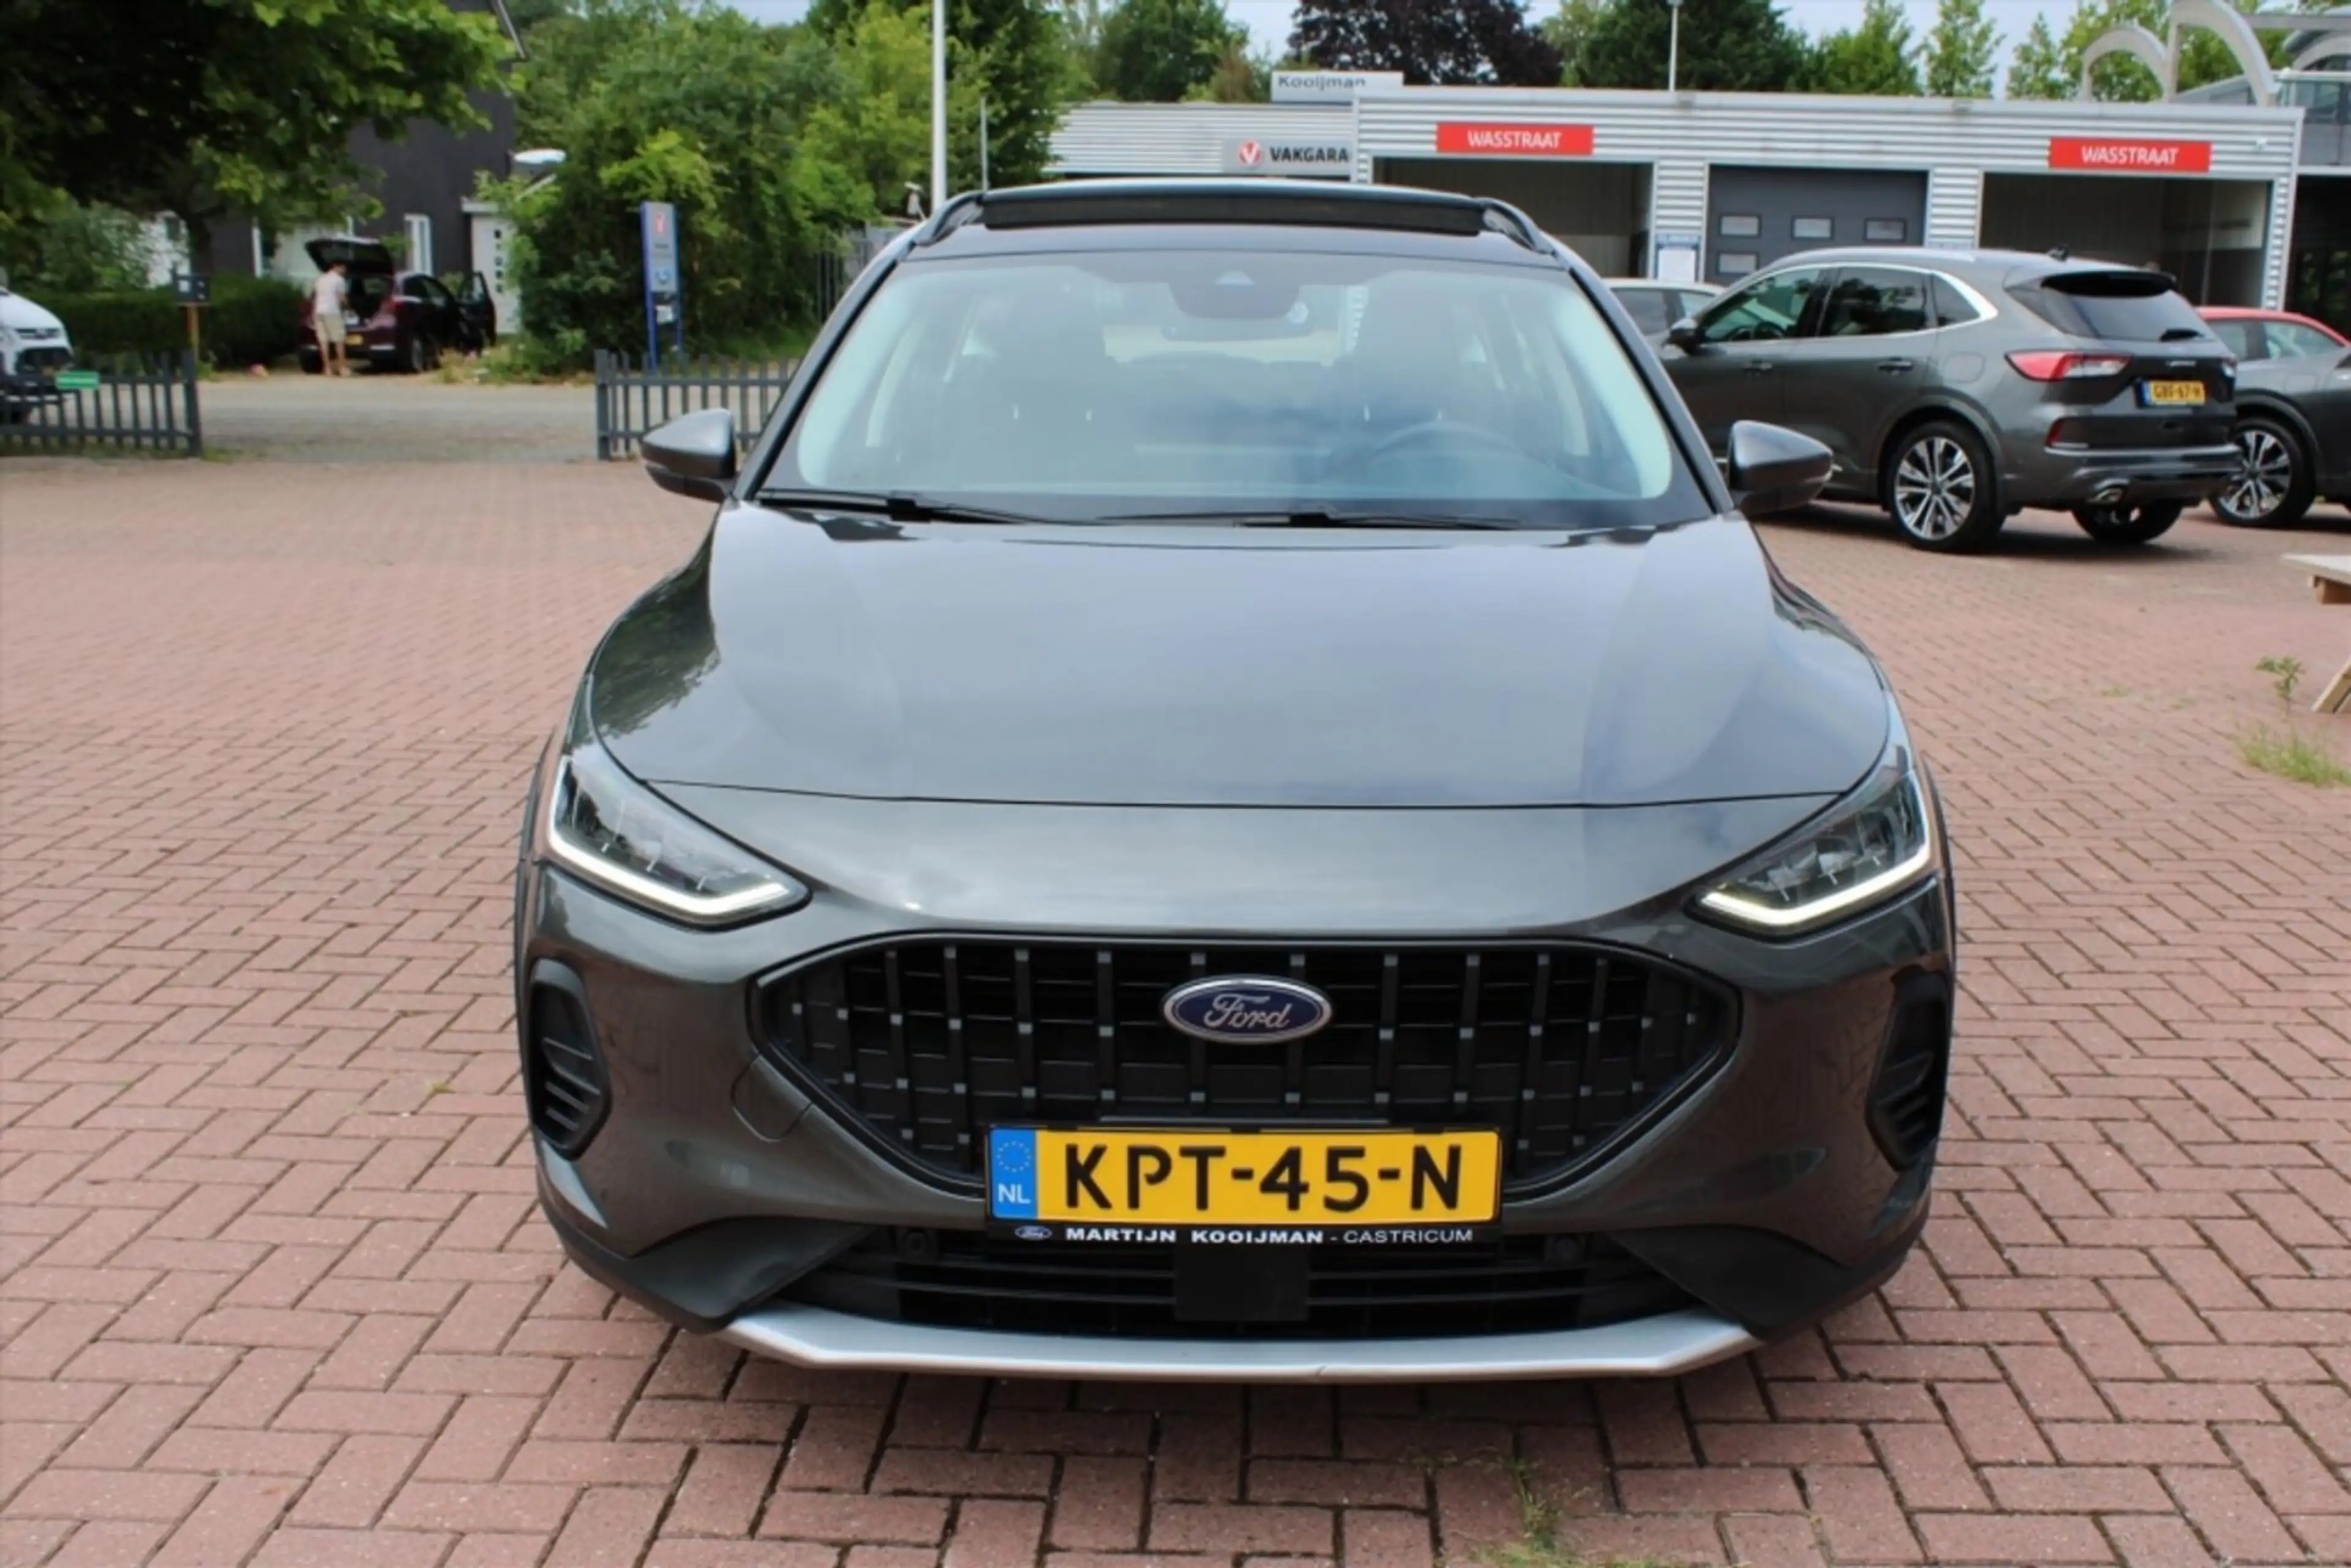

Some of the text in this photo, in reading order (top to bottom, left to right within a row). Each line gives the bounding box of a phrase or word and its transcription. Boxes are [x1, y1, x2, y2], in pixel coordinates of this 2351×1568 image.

[1278, 75, 1366, 91] Kooijman
[1467, 130, 1562, 149] WASSTRAAT
[1269, 146, 1349, 162] VAKGARA
[2082, 145, 2180, 165] WASSTRAAT
[1203, 992, 1292, 1027] Ford
[1065, 1144, 1461, 1211] KPT-45-N
[998, 1184, 1030, 1204] NL
[1066, 1228, 1176, 1242] MARTIJN
[1191, 1229, 1324, 1244] KOOIJMAN
[1343, 1228, 1472, 1244] CASTRICUM
